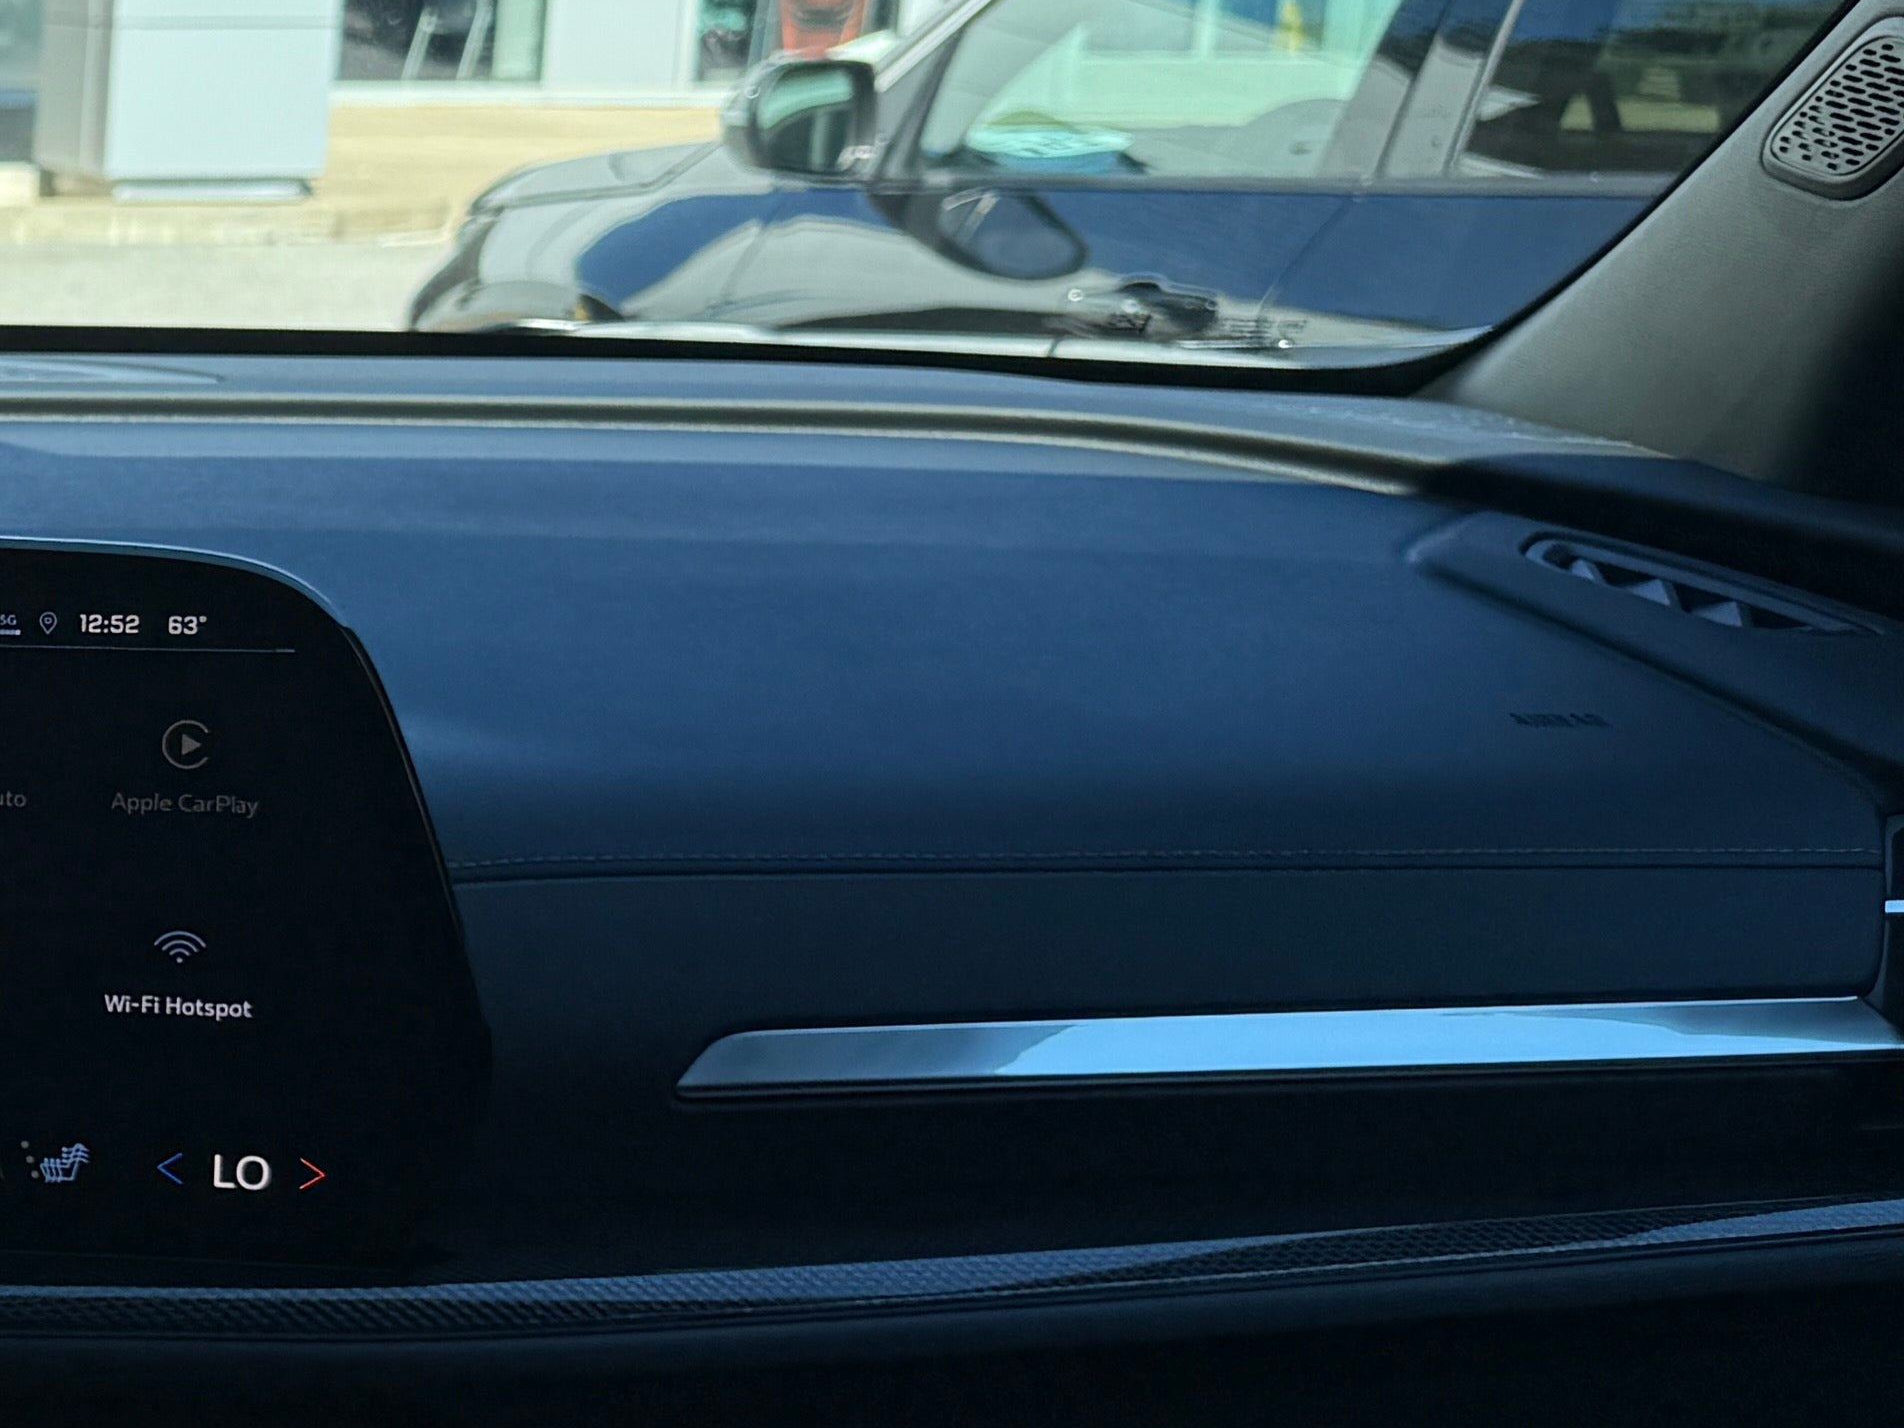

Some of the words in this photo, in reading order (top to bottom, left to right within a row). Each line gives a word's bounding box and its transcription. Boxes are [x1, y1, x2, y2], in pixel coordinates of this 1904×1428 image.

[79, 613, 140, 634] 12:52
[168, 615, 207, 635] 63°
[111, 792, 173, 815] Apple
[178, 793, 259, 819] CarPlay
[104, 994, 160, 1014] Wi-Fi
[165, 996, 252, 1022] Hotspot
[213, 1154, 270, 1191] LO
